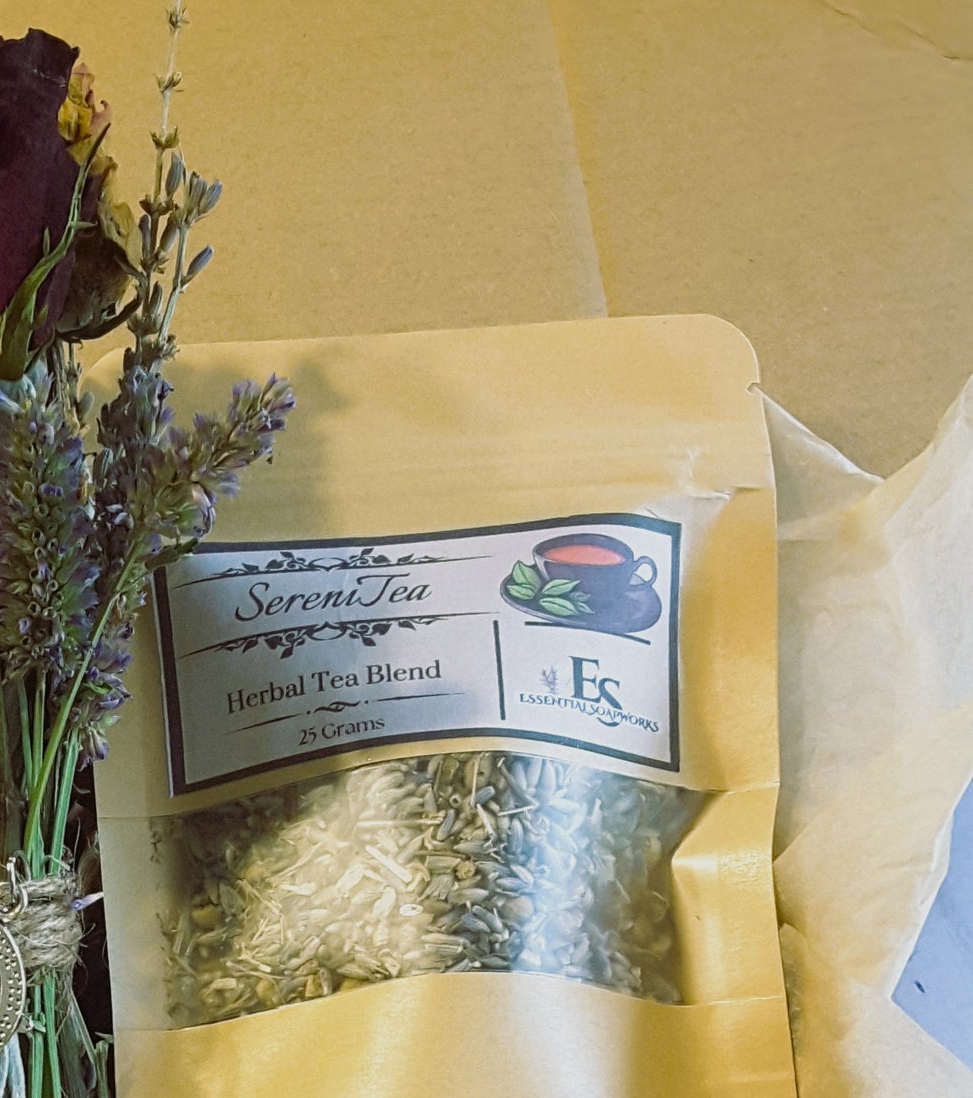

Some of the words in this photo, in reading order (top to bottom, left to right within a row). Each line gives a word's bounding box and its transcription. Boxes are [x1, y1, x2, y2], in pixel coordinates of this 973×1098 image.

[227, 674, 305, 715] Herbal
[310, 669, 359, 694] Tea
[366, 659, 441, 687] Blend
[298, 728, 317, 746] 25
[321, 716, 386, 741] Grams
